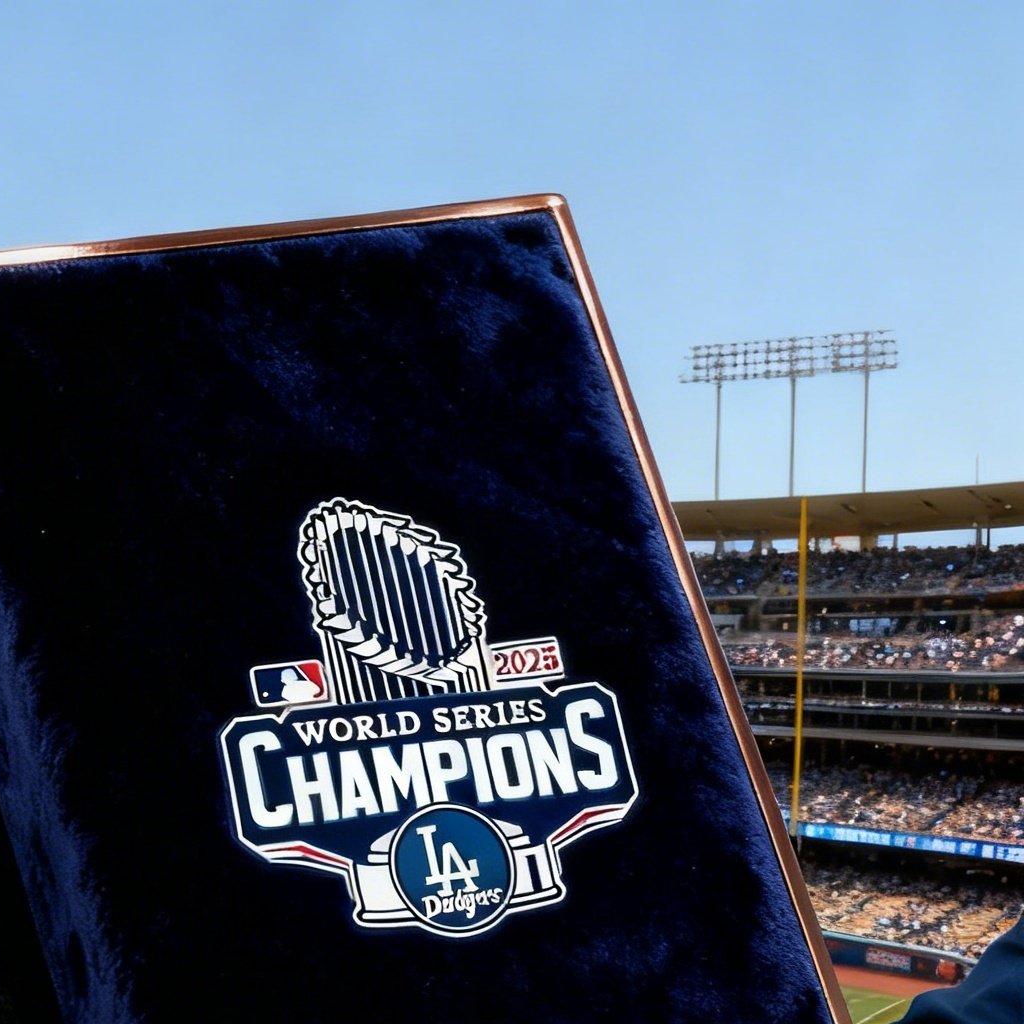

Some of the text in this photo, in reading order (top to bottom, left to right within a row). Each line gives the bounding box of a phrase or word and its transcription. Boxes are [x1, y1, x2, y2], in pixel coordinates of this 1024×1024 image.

[493, 645, 560, 676] 2025
[291, 698, 547, 746] WORLD SERIES
[238, 698, 619, 829] CHAMPIONS
[416, 824, 480, 898] LA
